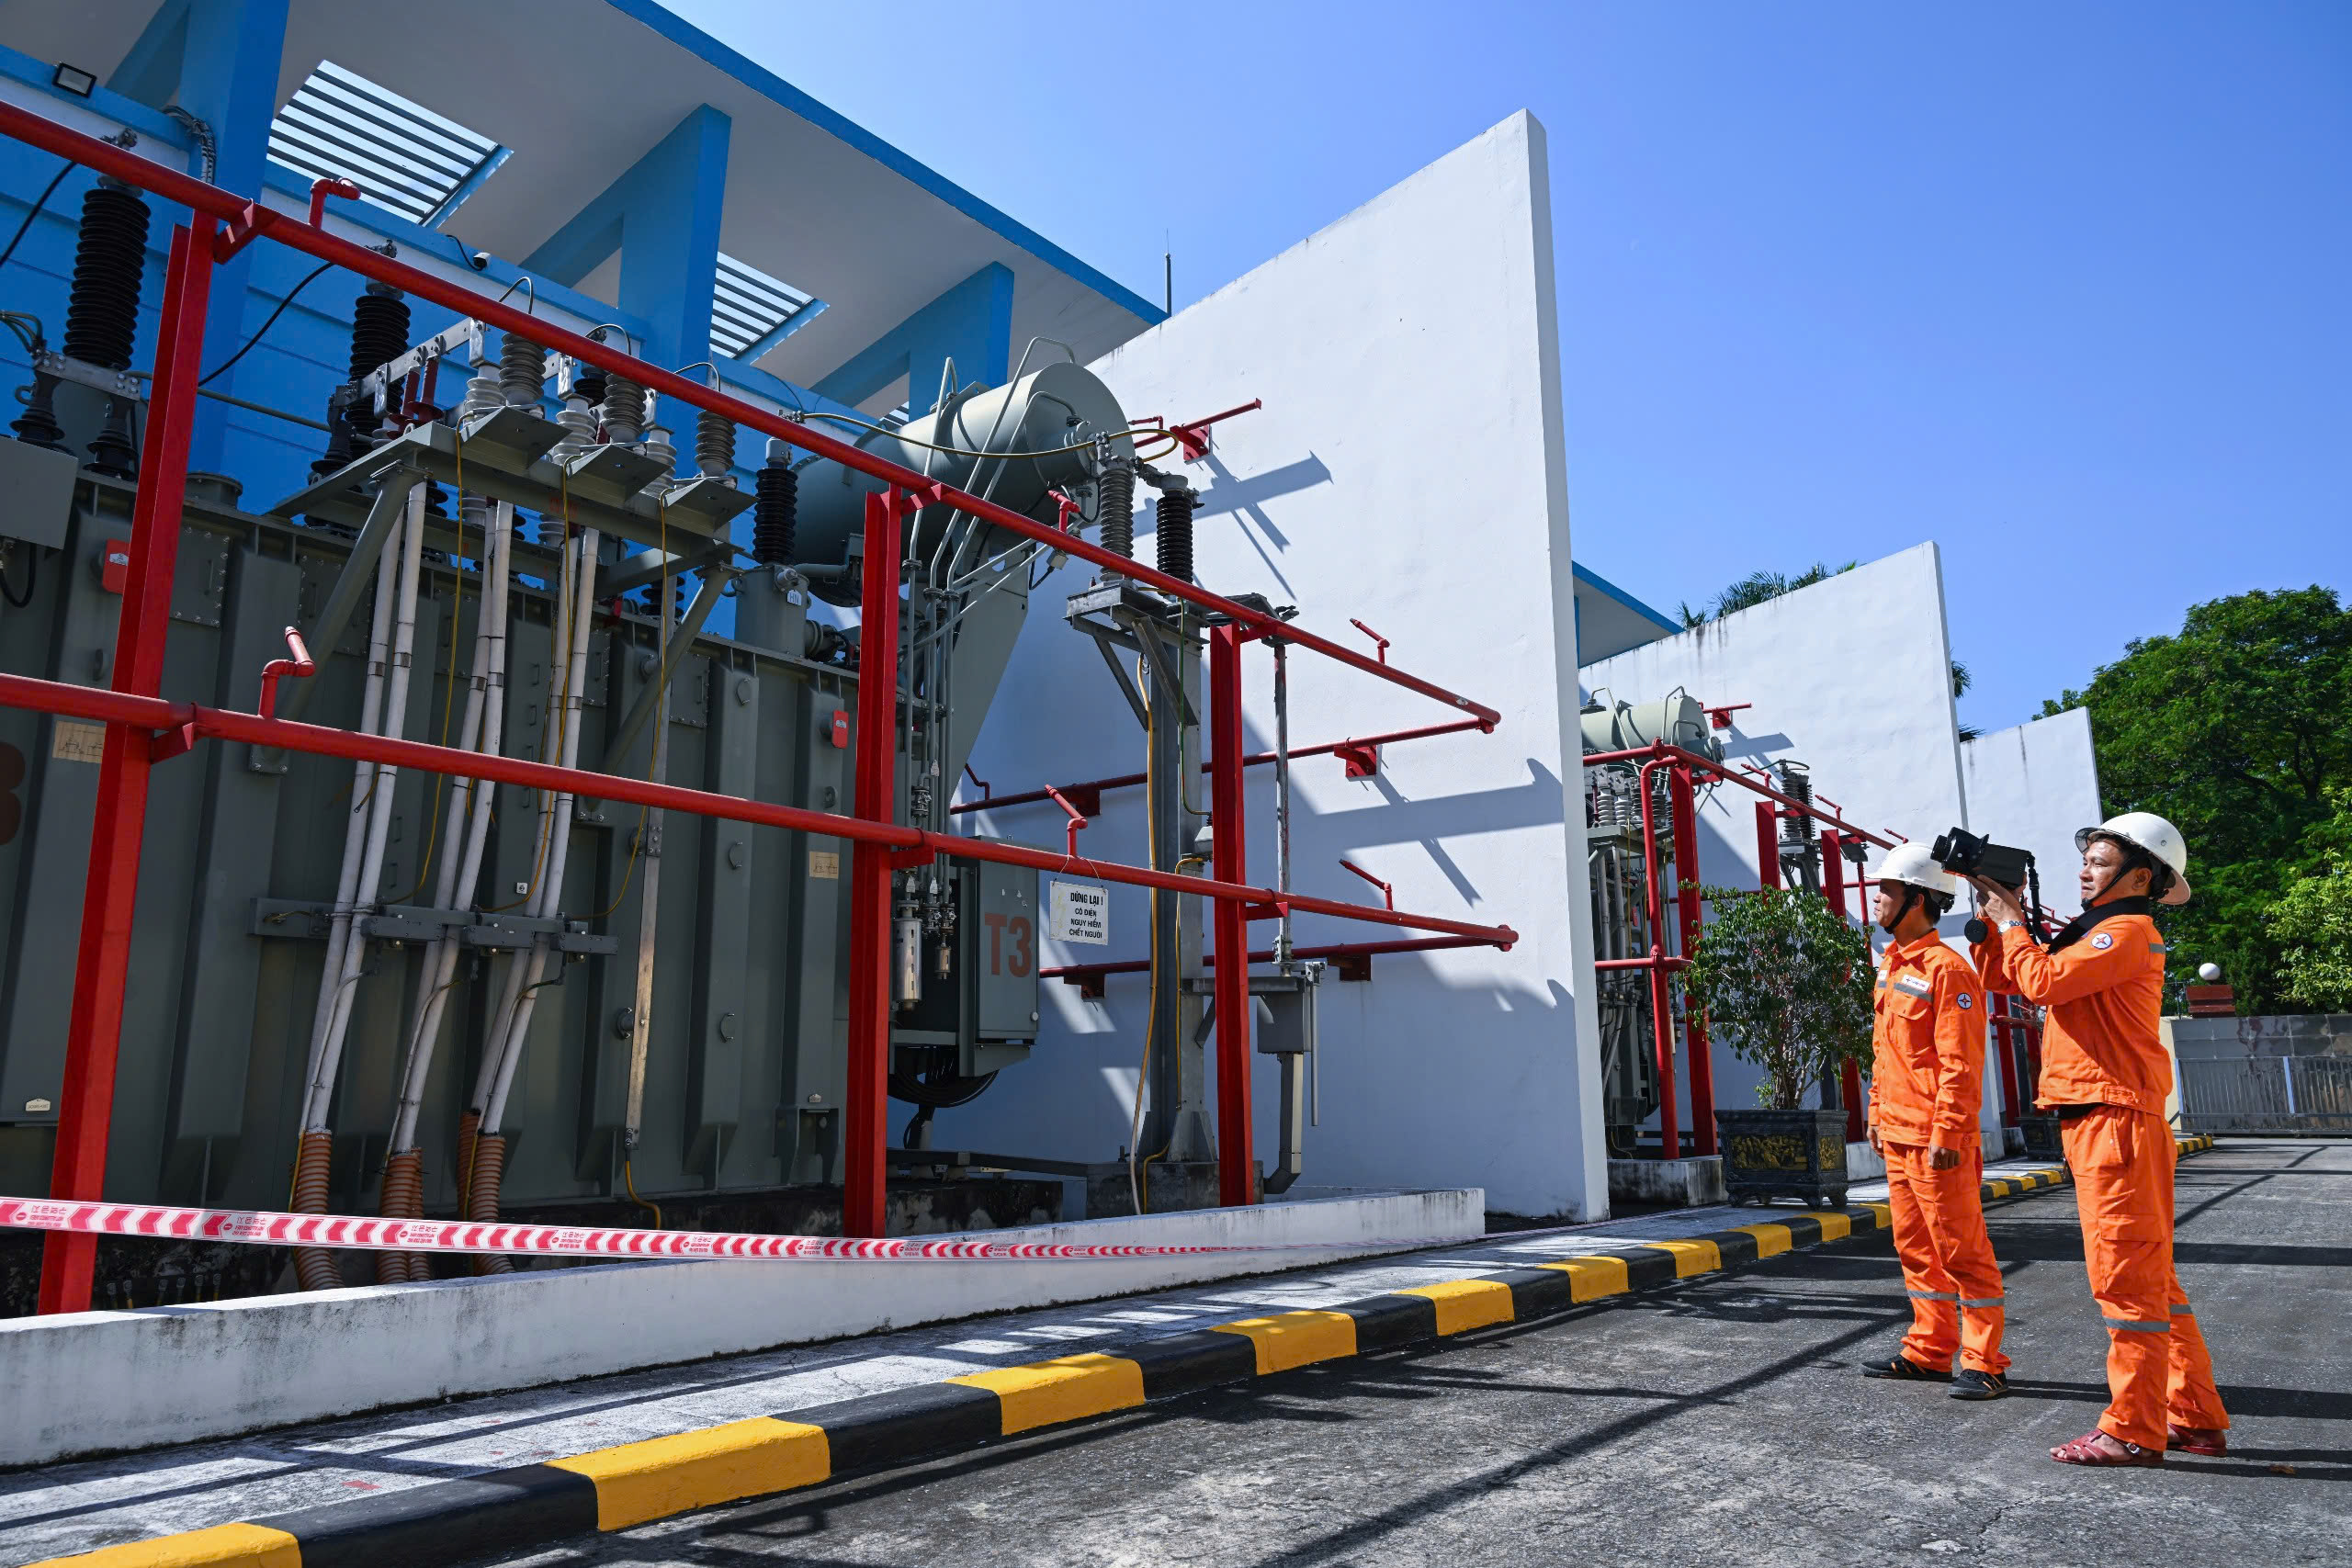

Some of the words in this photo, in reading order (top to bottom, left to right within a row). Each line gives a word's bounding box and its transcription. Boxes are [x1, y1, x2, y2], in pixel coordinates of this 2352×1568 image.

[1089, 895, 1100, 907] LẠI
[1075, 907, 1082, 915] CÓ
[1084, 908, 1097, 918] ĐIỆN
[1087, 918, 1102, 928] HIỂM
[1069, 927, 1083, 936] CHẾT
[1084, 930, 1102, 939] NGƯỜI
[985, 913, 1033, 977] T3
